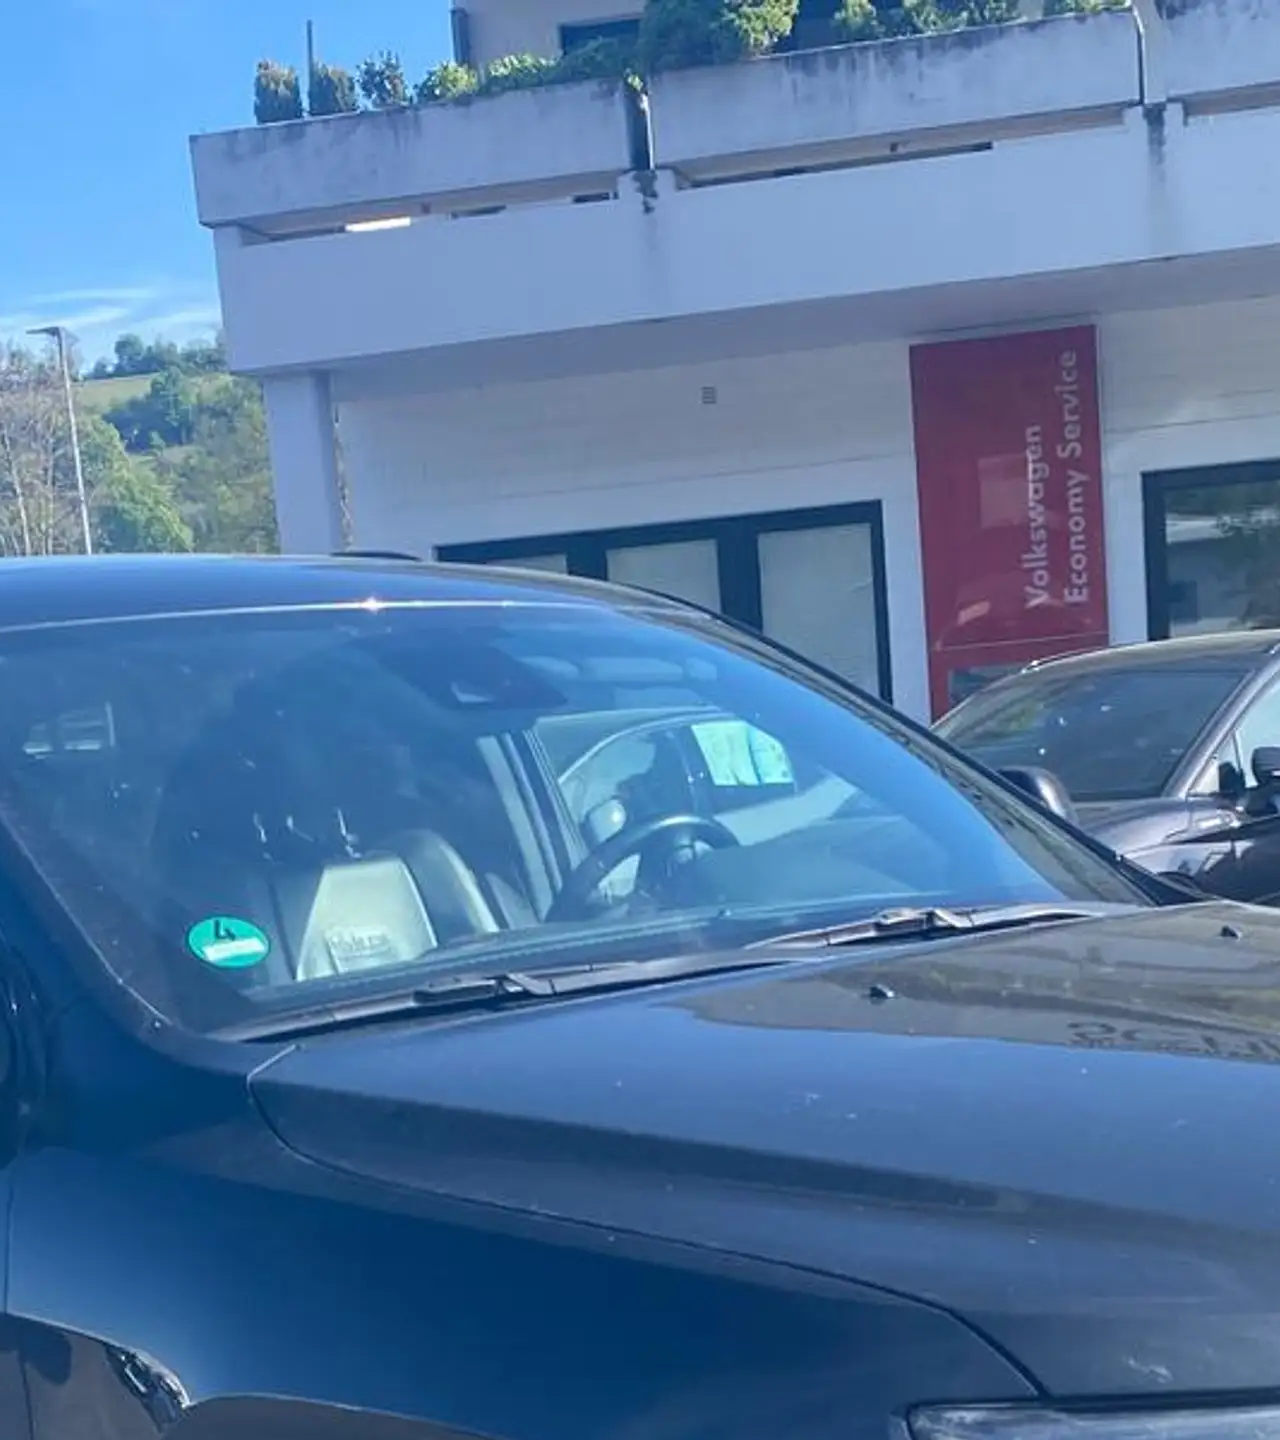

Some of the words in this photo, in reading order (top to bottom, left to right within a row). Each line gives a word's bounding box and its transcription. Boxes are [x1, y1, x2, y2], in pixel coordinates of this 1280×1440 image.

[1054, 350, 1082, 460] Service
[1022, 425, 1050, 609] Volkswagen
[1063, 469, 1090, 604] Economy
